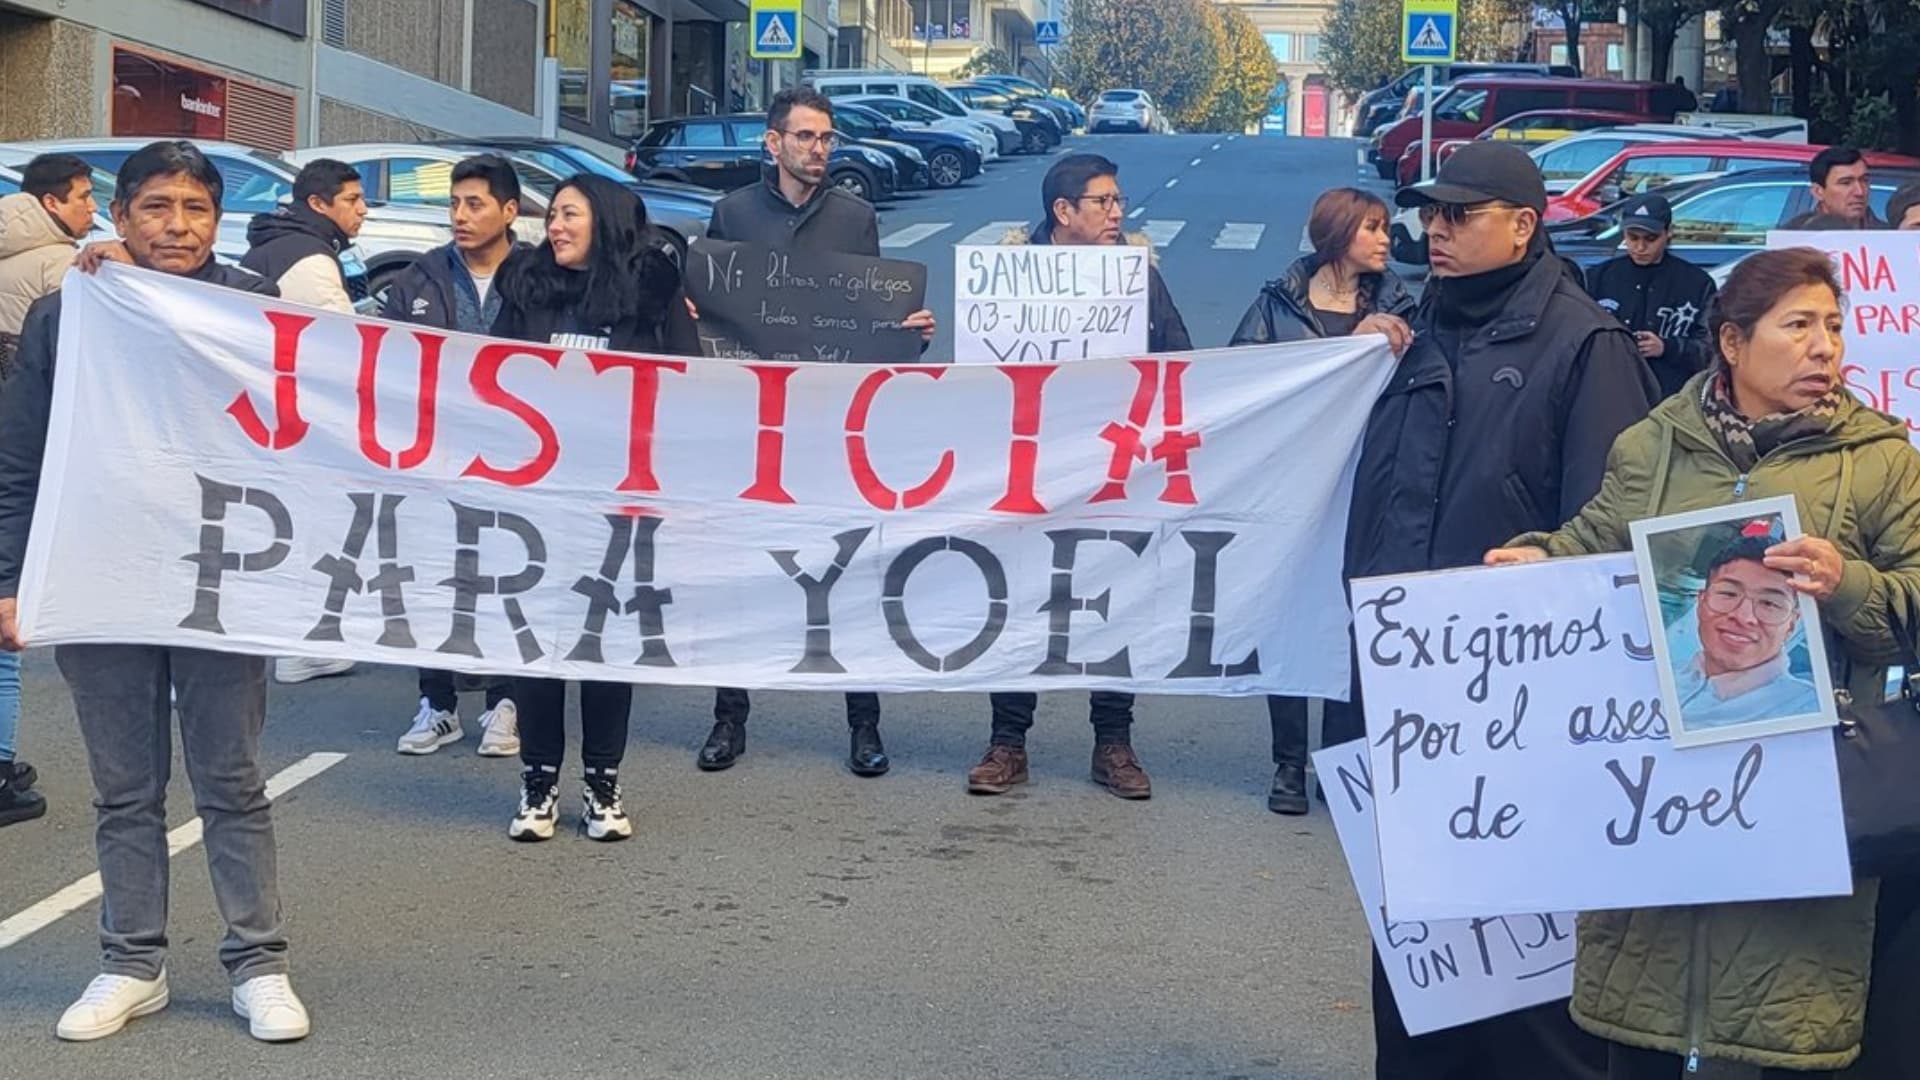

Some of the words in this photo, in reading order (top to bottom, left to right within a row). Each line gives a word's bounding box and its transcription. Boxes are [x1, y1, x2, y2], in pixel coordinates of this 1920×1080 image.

[707, 251, 742, 293] Ni
[846, 267, 912, 302] gallegos
[967, 250, 1086, 297] SAMUEL
[1102, 254, 1145, 297] LIZ
[1829, 246, 1896, 293] NA
[752, 300, 798, 326] todos
[812, 315, 858, 331] somos
[226, 311, 1203, 514] JUSTICIA
[176, 472, 677, 668] PARA
[767, 525, 1261, 679] YOEL
[1358, 585, 1610, 703] Exigimos
[1373, 707, 1466, 795] por
[1486, 684, 1528, 751] el
[1568, 697, 1671, 745] ases
[1449, 776, 1526, 840] de
[1605, 742, 1764, 847] Yoel
[1406, 943, 1459, 989] UN
